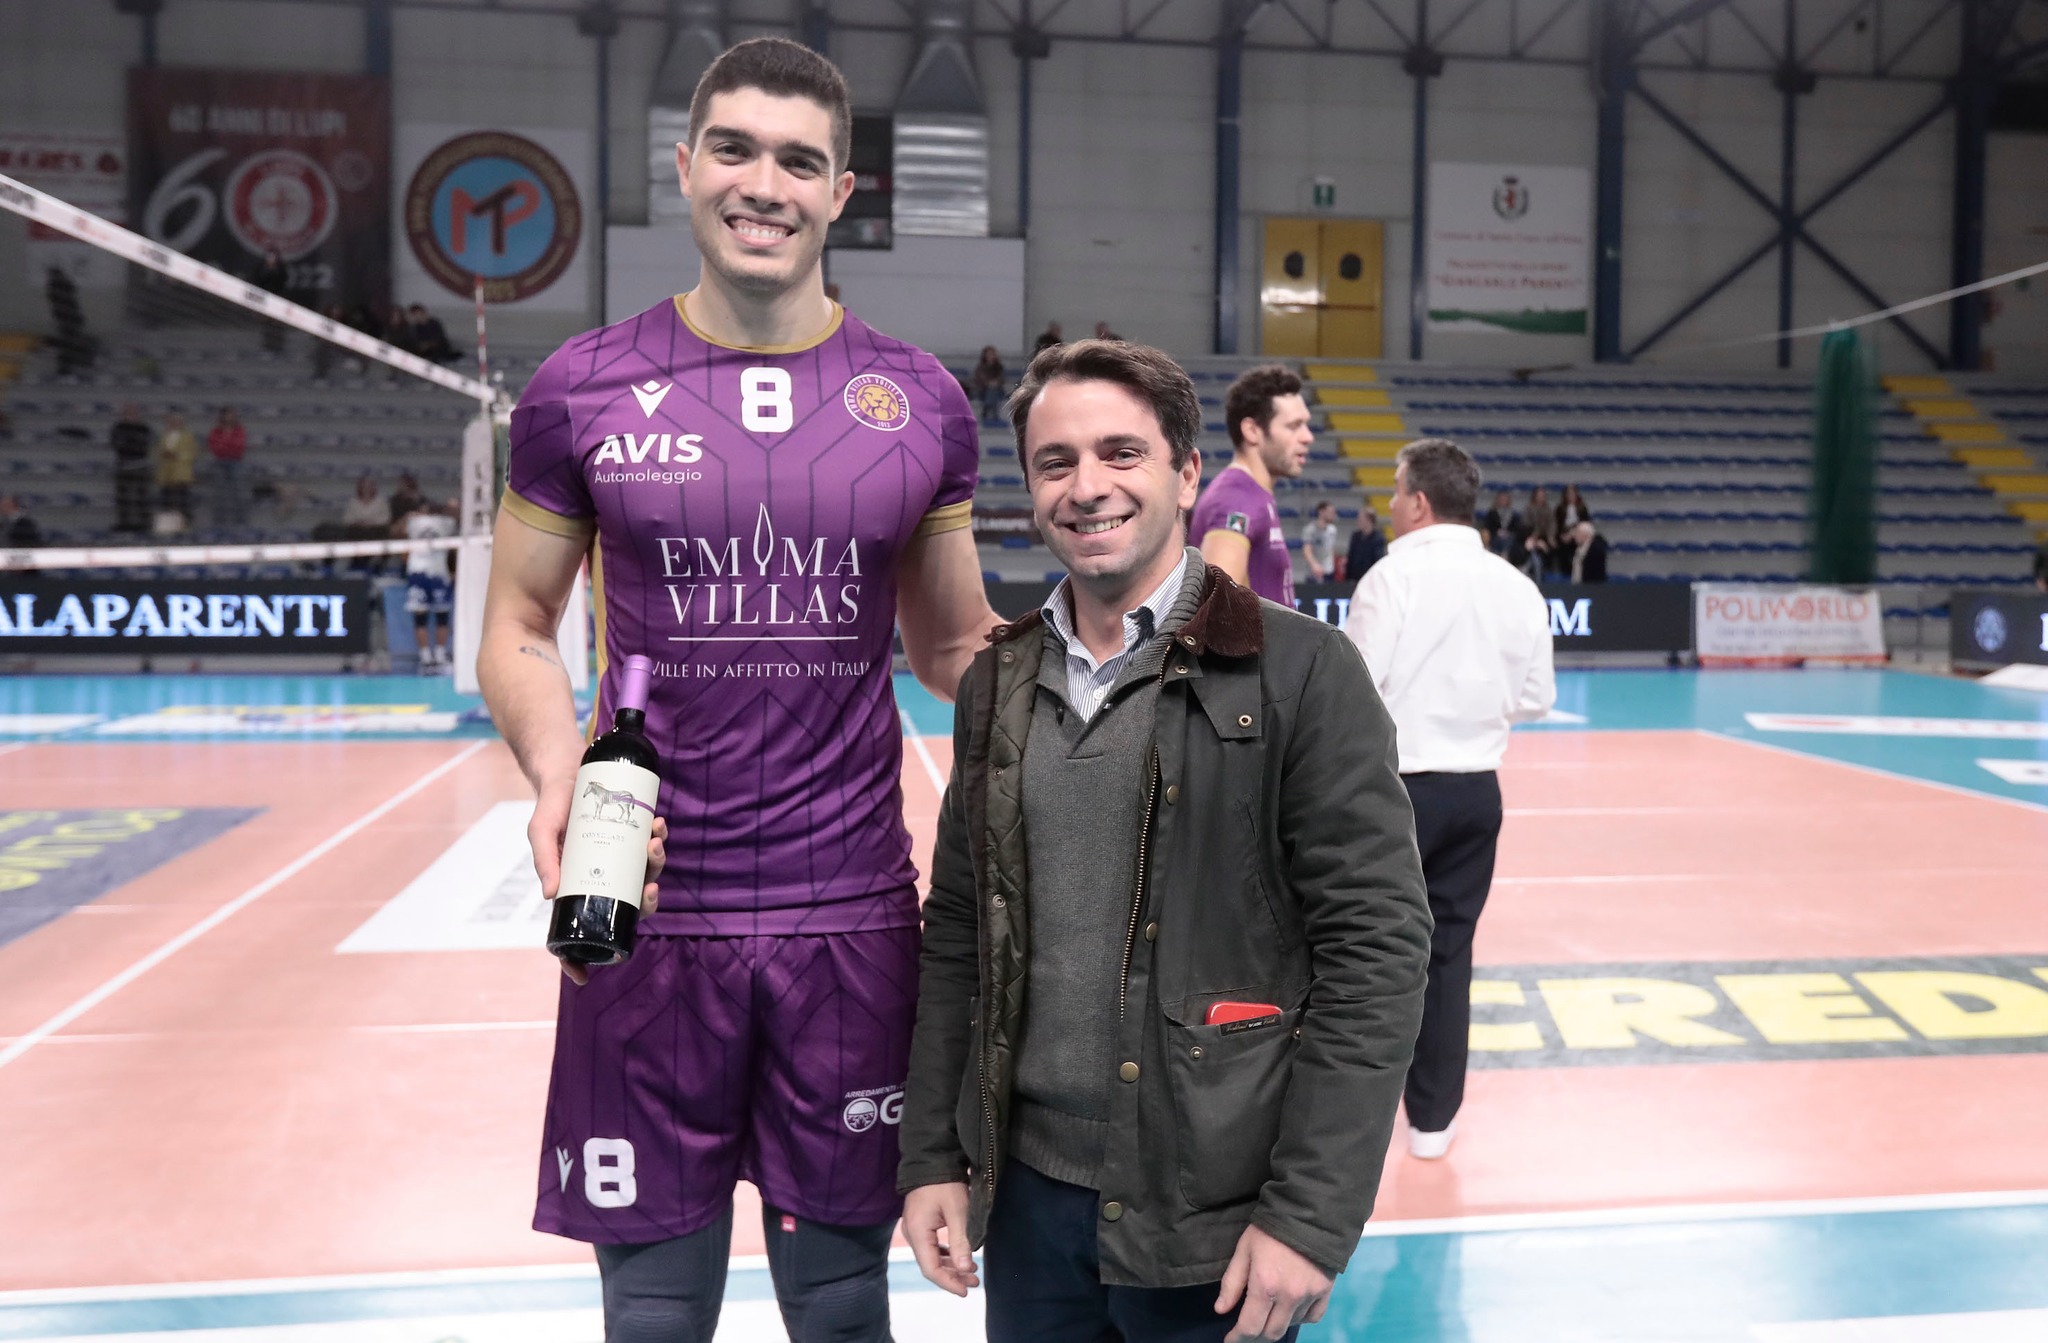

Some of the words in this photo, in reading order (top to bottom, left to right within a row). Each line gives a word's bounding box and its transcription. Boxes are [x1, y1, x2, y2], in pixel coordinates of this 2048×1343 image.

[740, 367, 793, 433] 8
[594, 434, 704, 465] AVIS
[595, 468, 702, 484] Autonoleggio
[656, 537, 863, 577] EMMA
[665, 584, 860, 625] VILLAS
[1703, 596, 1871, 622] POLIWORLD
[696, 663, 716, 677] IN
[723, 663, 801, 677] AFFITTO
[807, 663, 825, 677] IN
[845, 1085, 897, 1098] ARREDAMENTI
[583, 1137, 637, 1208] 8
